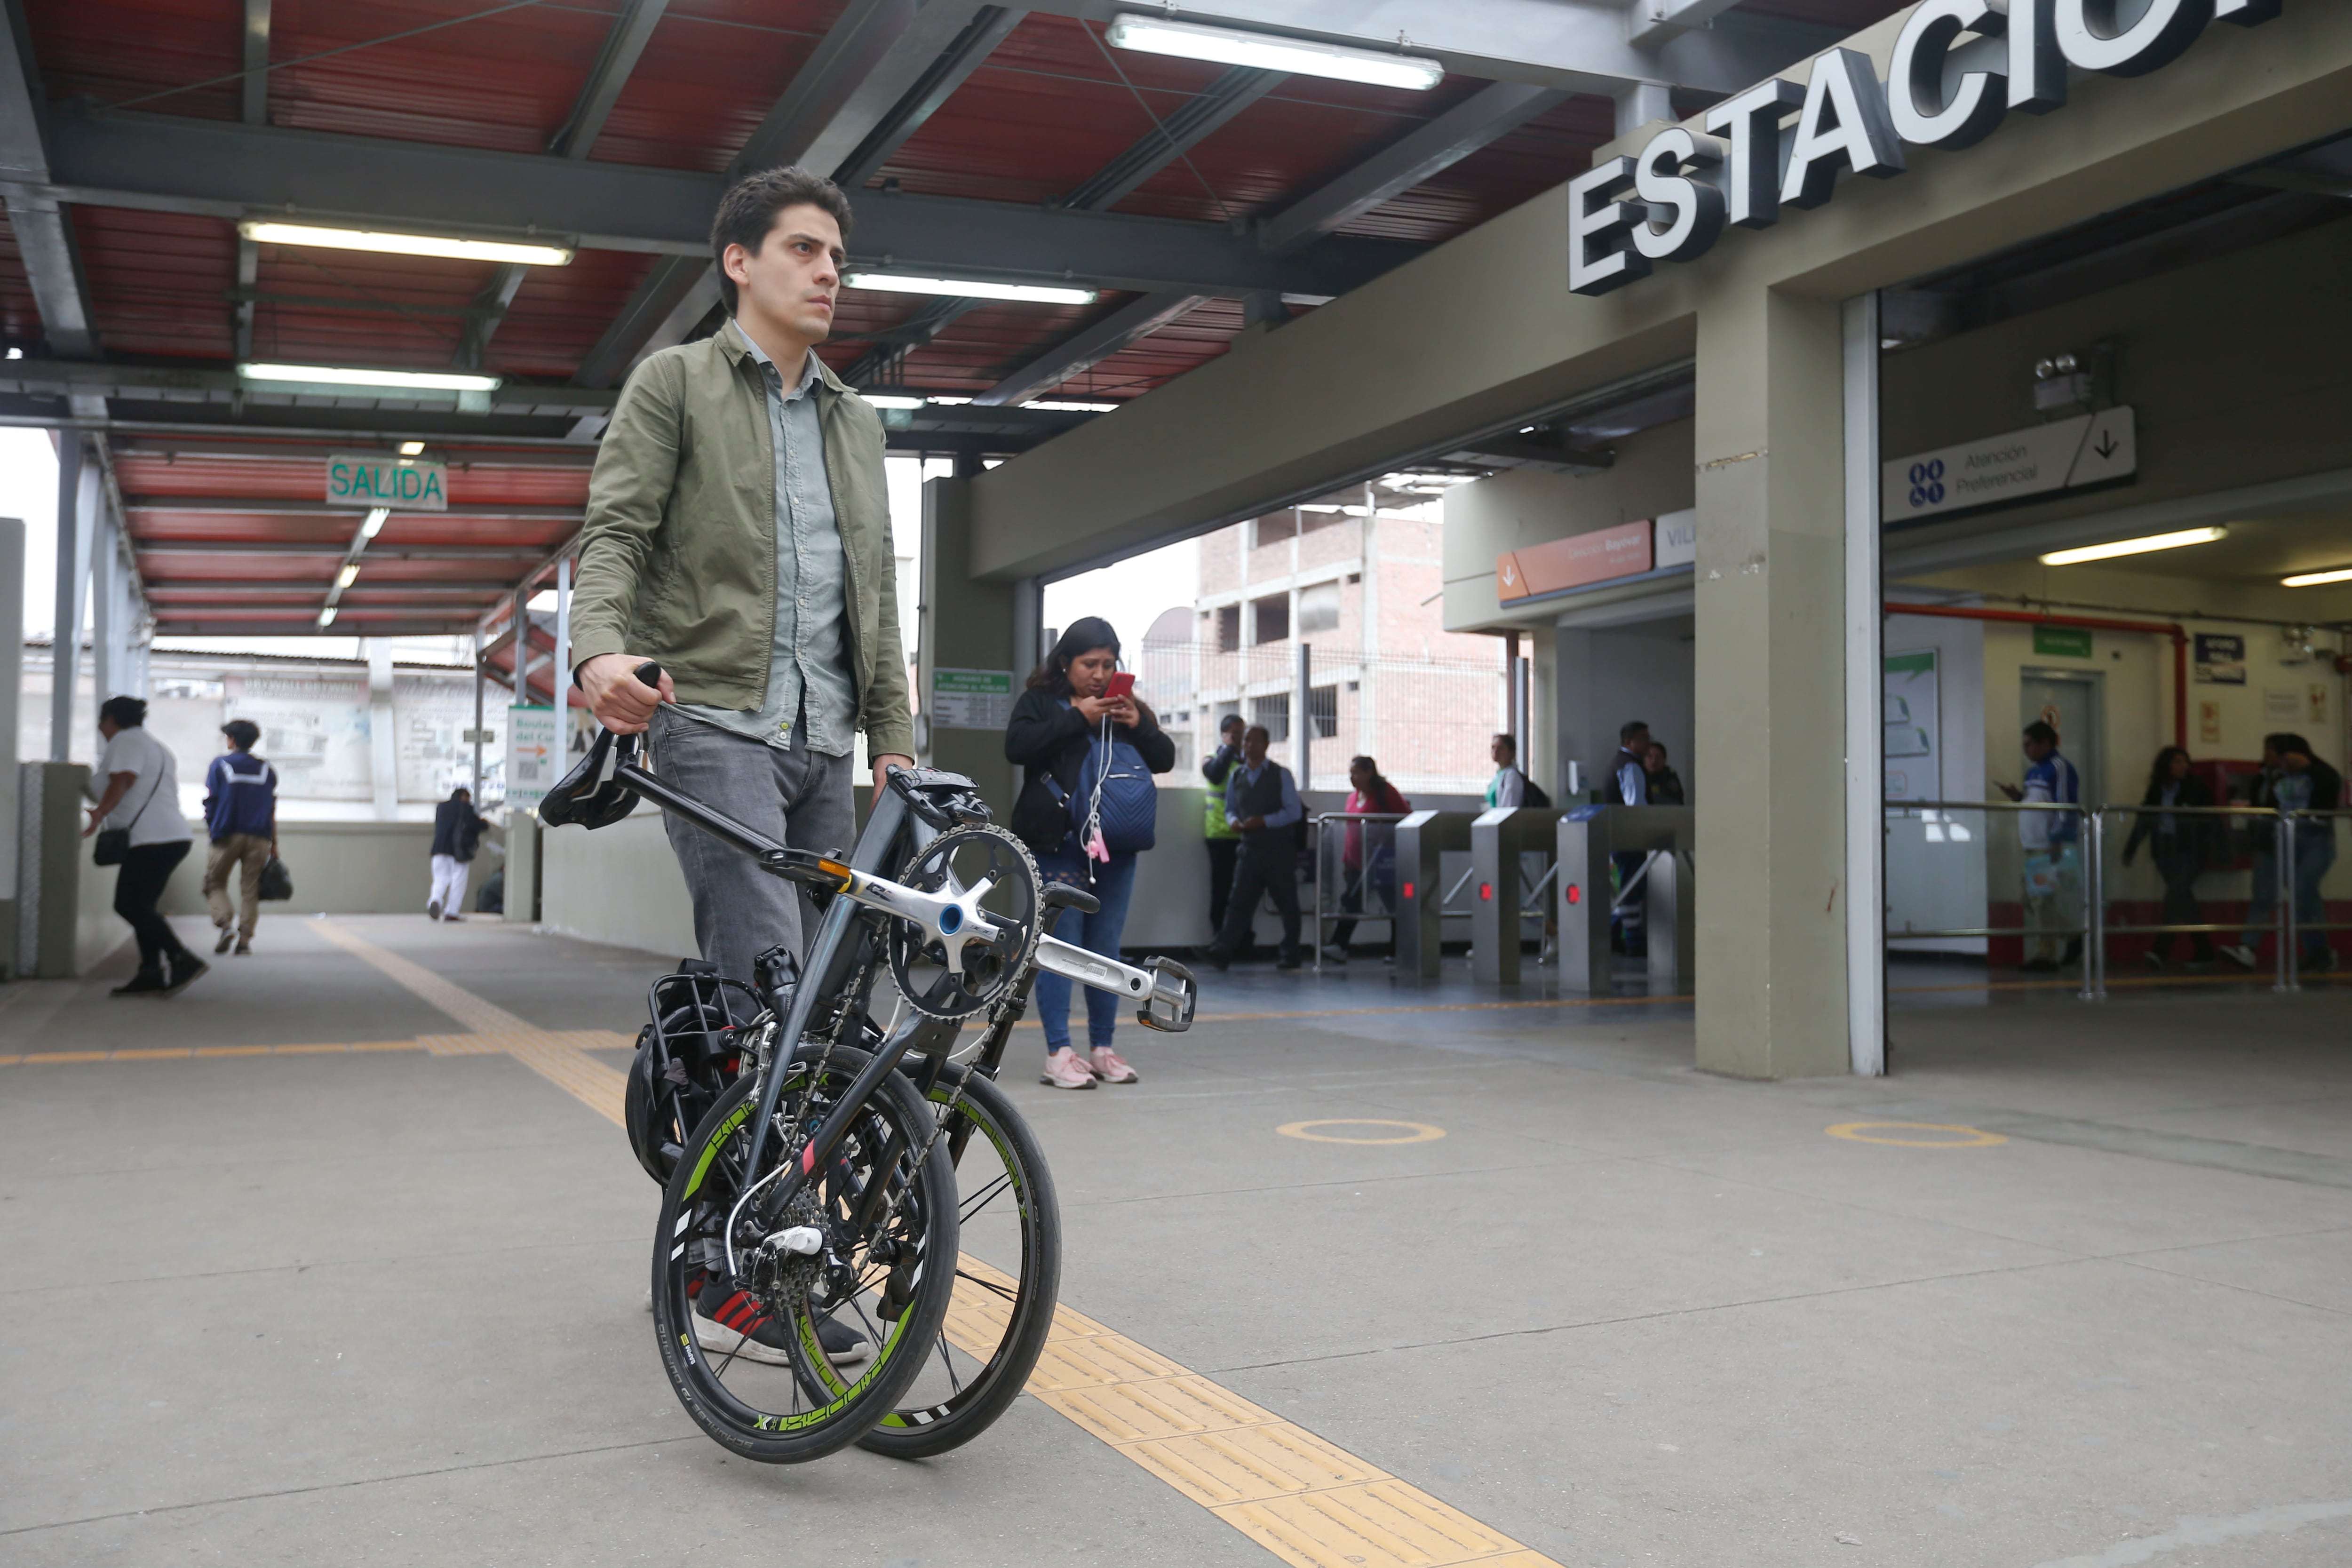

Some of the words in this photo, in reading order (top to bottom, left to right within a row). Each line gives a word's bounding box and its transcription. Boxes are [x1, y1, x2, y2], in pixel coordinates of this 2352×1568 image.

[1568, 0, 2280, 295] ESTACIO
[331, 463, 443, 501] SALIDA
[516, 717, 574, 731] Boulevd
[685, 1345, 696, 1365] SAPIM
[692, 1403, 754, 1449] SCHWALBE
